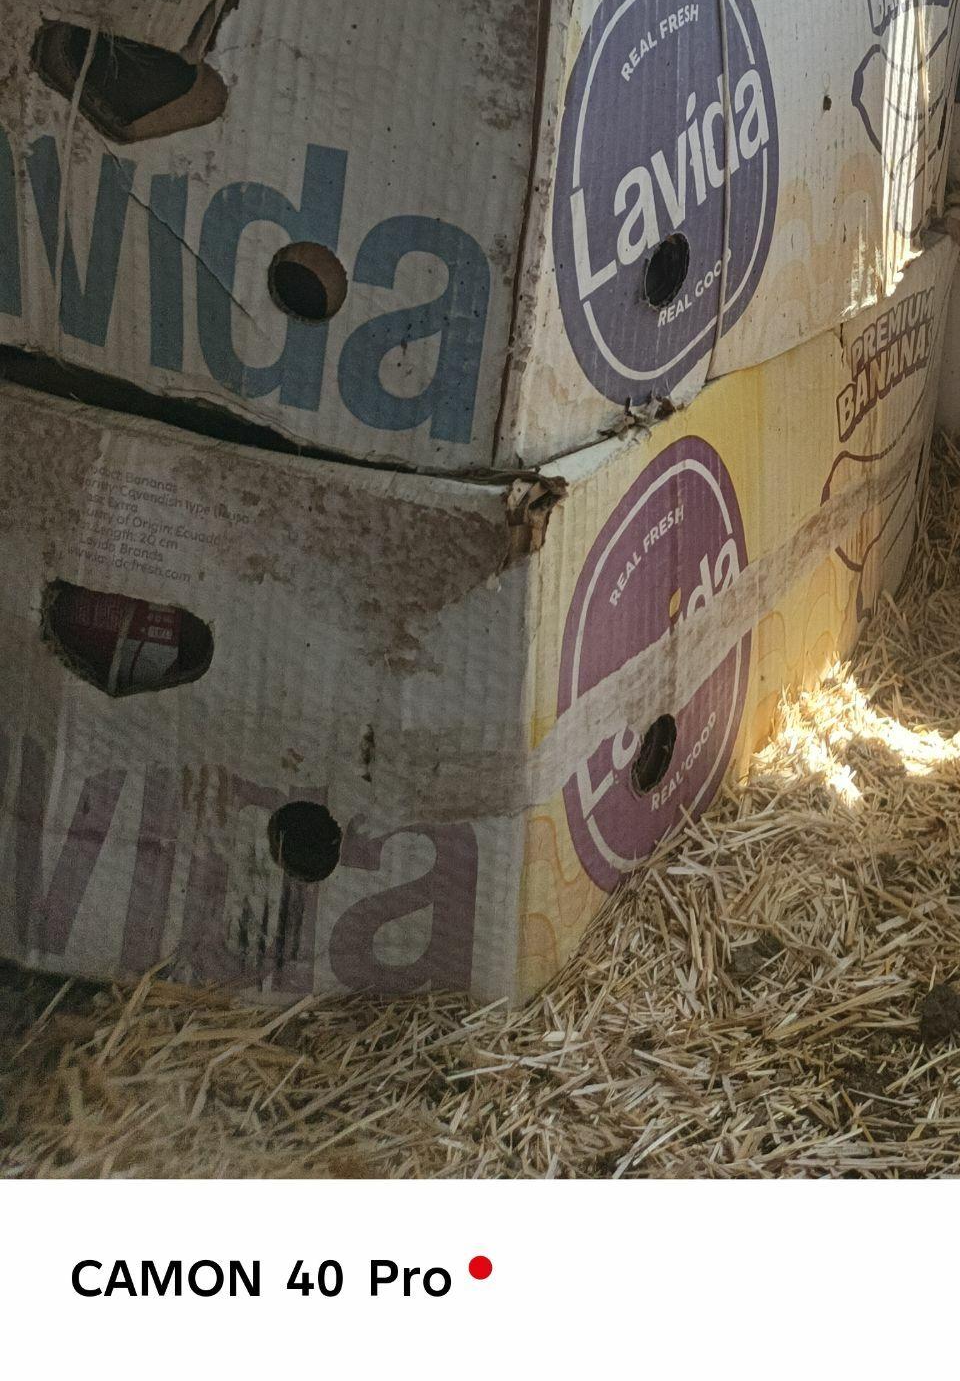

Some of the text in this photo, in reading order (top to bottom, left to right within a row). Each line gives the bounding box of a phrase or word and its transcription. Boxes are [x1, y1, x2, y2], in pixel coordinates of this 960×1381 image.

[619, 3, 700, 82] REAL FRESH
[569, 65, 771, 301] Lavida
[0, 131, 491, 445] vida
[657, 293, 693, 328] REAL
[851, 285, 936, 382] PREMIUM
[608, 505, 685, 608] REAL FRESH
[650, 710, 717, 813] REAL GOOD
